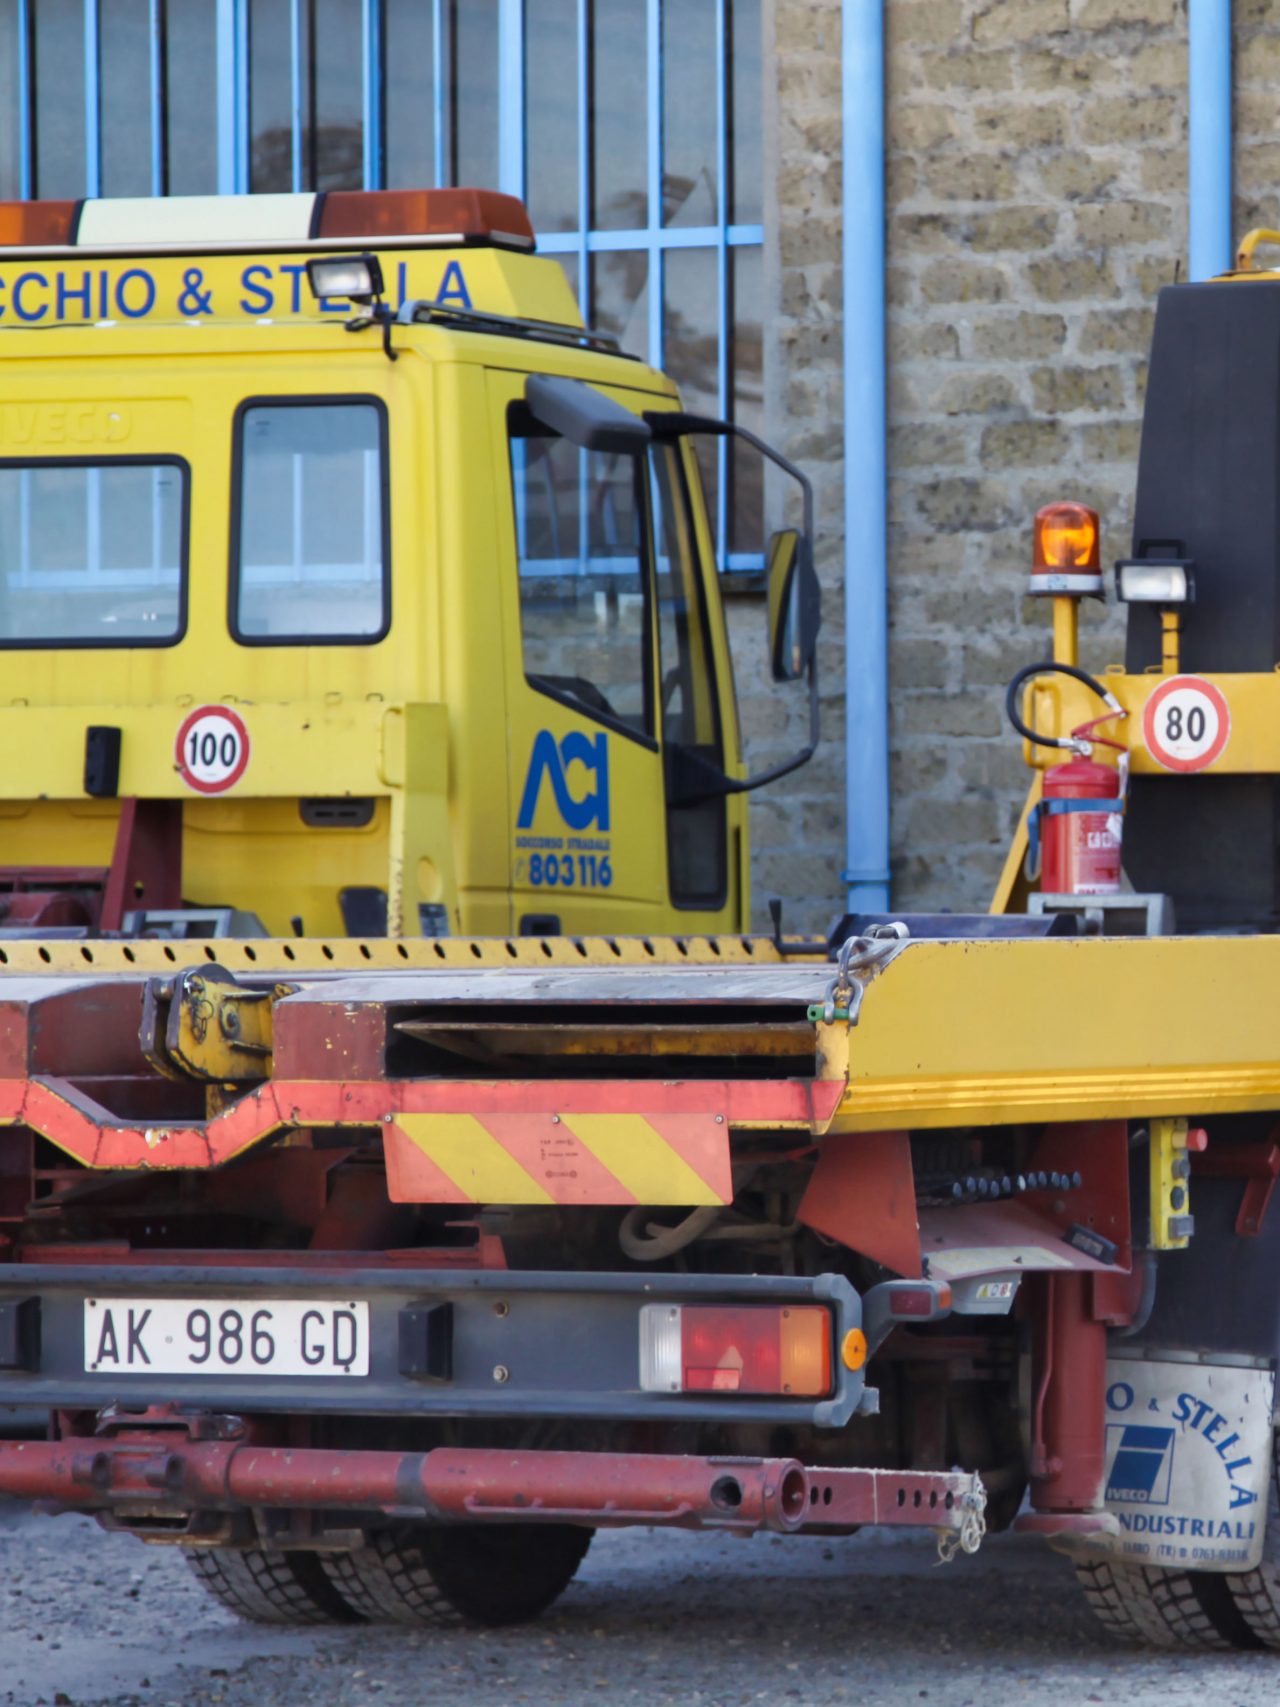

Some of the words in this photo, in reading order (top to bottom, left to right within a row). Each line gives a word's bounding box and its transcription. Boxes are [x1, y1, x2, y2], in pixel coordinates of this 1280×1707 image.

[0, 268, 156, 322] CHIO
[177, 267, 214, 317] &
[0, 406, 133, 445] VECO
[1166, 706, 1206, 742] 80
[190, 731, 237, 767] 100
[516, 729, 610, 832] ACI
[529, 853, 613, 888] 803116
[96, 1308, 153, 1365] AK
[186, 1308, 276, 1365] 986
[300, 1310, 358, 1366] GD
[1172, 1392, 1259, 1510] STELLA
[1107, 1487, 1149, 1501] IVECO
